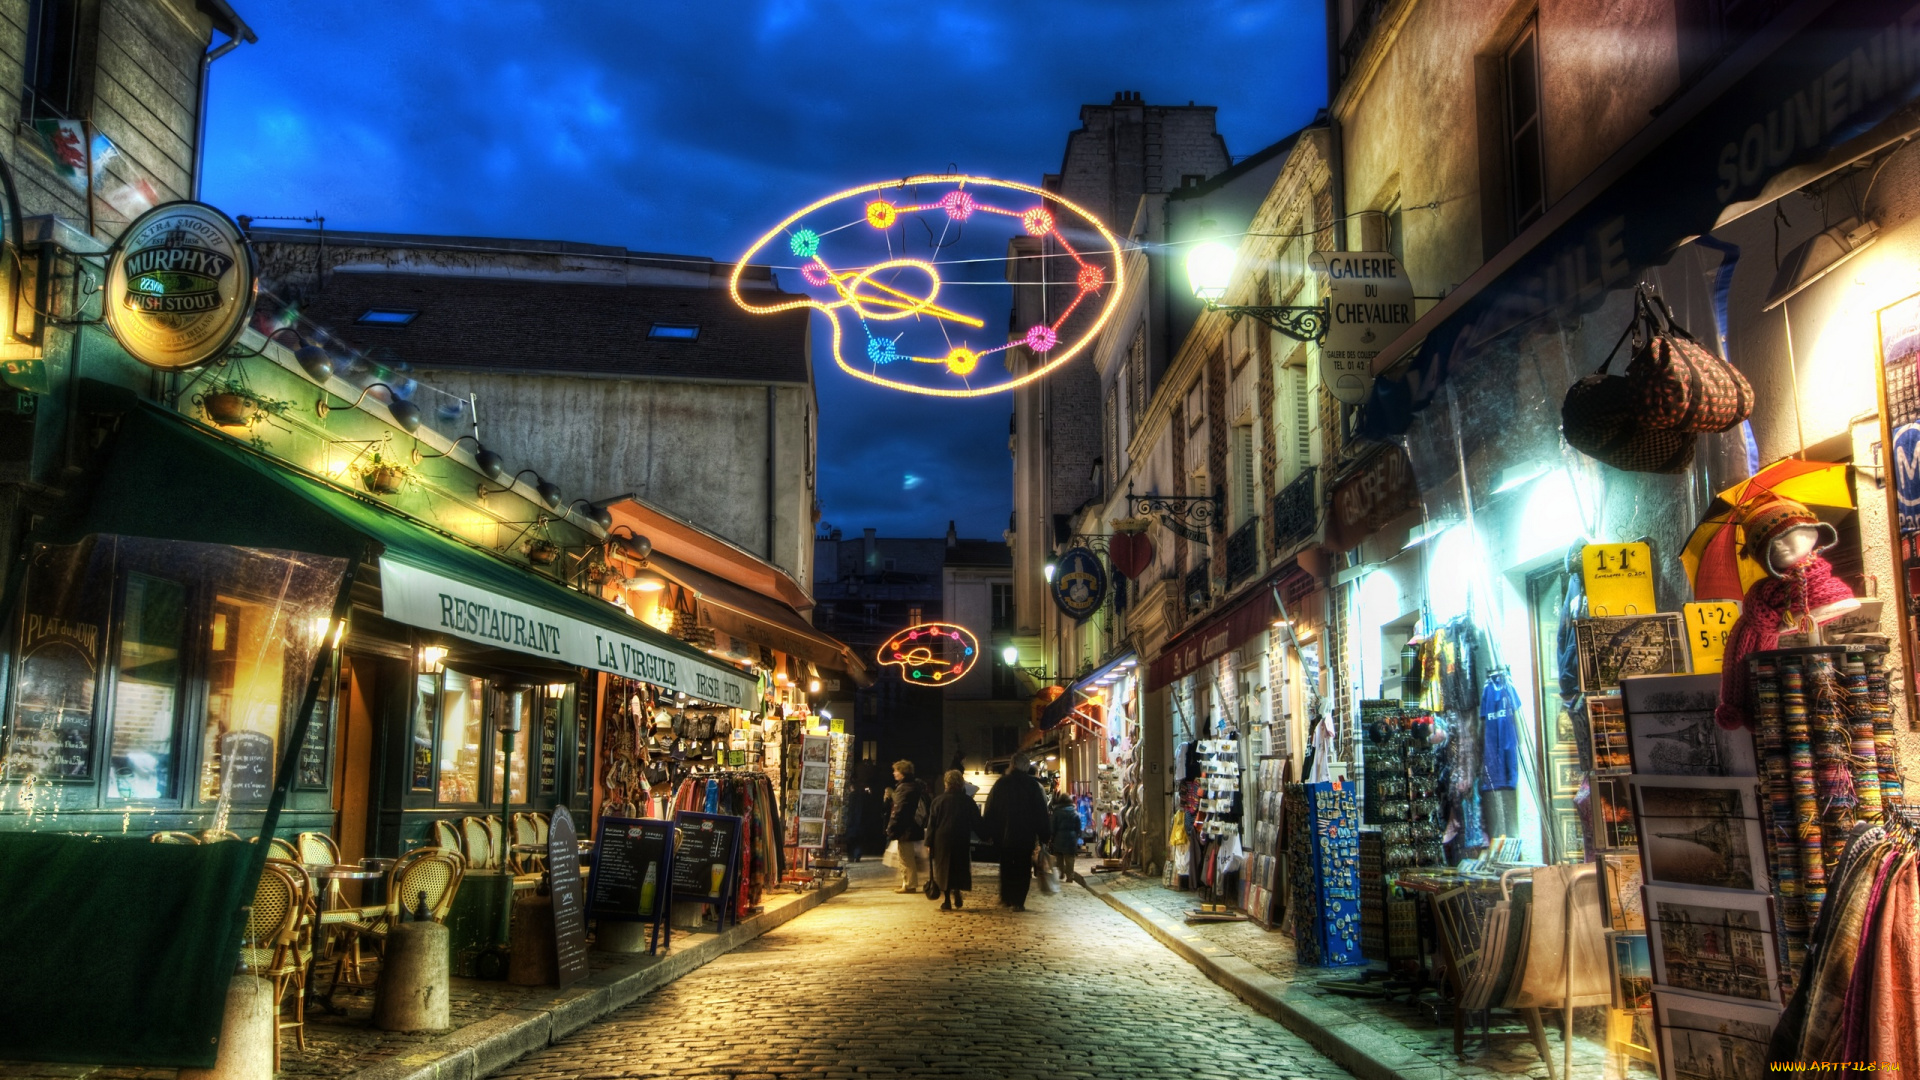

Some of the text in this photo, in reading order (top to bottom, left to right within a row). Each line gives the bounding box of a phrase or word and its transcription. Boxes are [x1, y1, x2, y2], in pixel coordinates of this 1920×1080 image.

[136, 219, 224, 247] EXTRA SMOOTH
[127, 249, 225, 281] MURPHY'S
[1329, 257, 1397, 279] GALERIE
[128, 293, 215, 311] IRISH STOUT
[1364, 284, 1378, 298] DU
[1335, 302, 1410, 325] CHEVALIER
[186, 313, 216, 338] IRELAND
[1346, 350, 1356, 359] DES
[1347, 361, 1355, 371] 01
[1356, 361, 1365, 371] 42
[26, 613, 98, 660] PLAT du JOUR
[438, 593, 741, 705] RESTAURANT LA VIRGULE IRISH PUB
